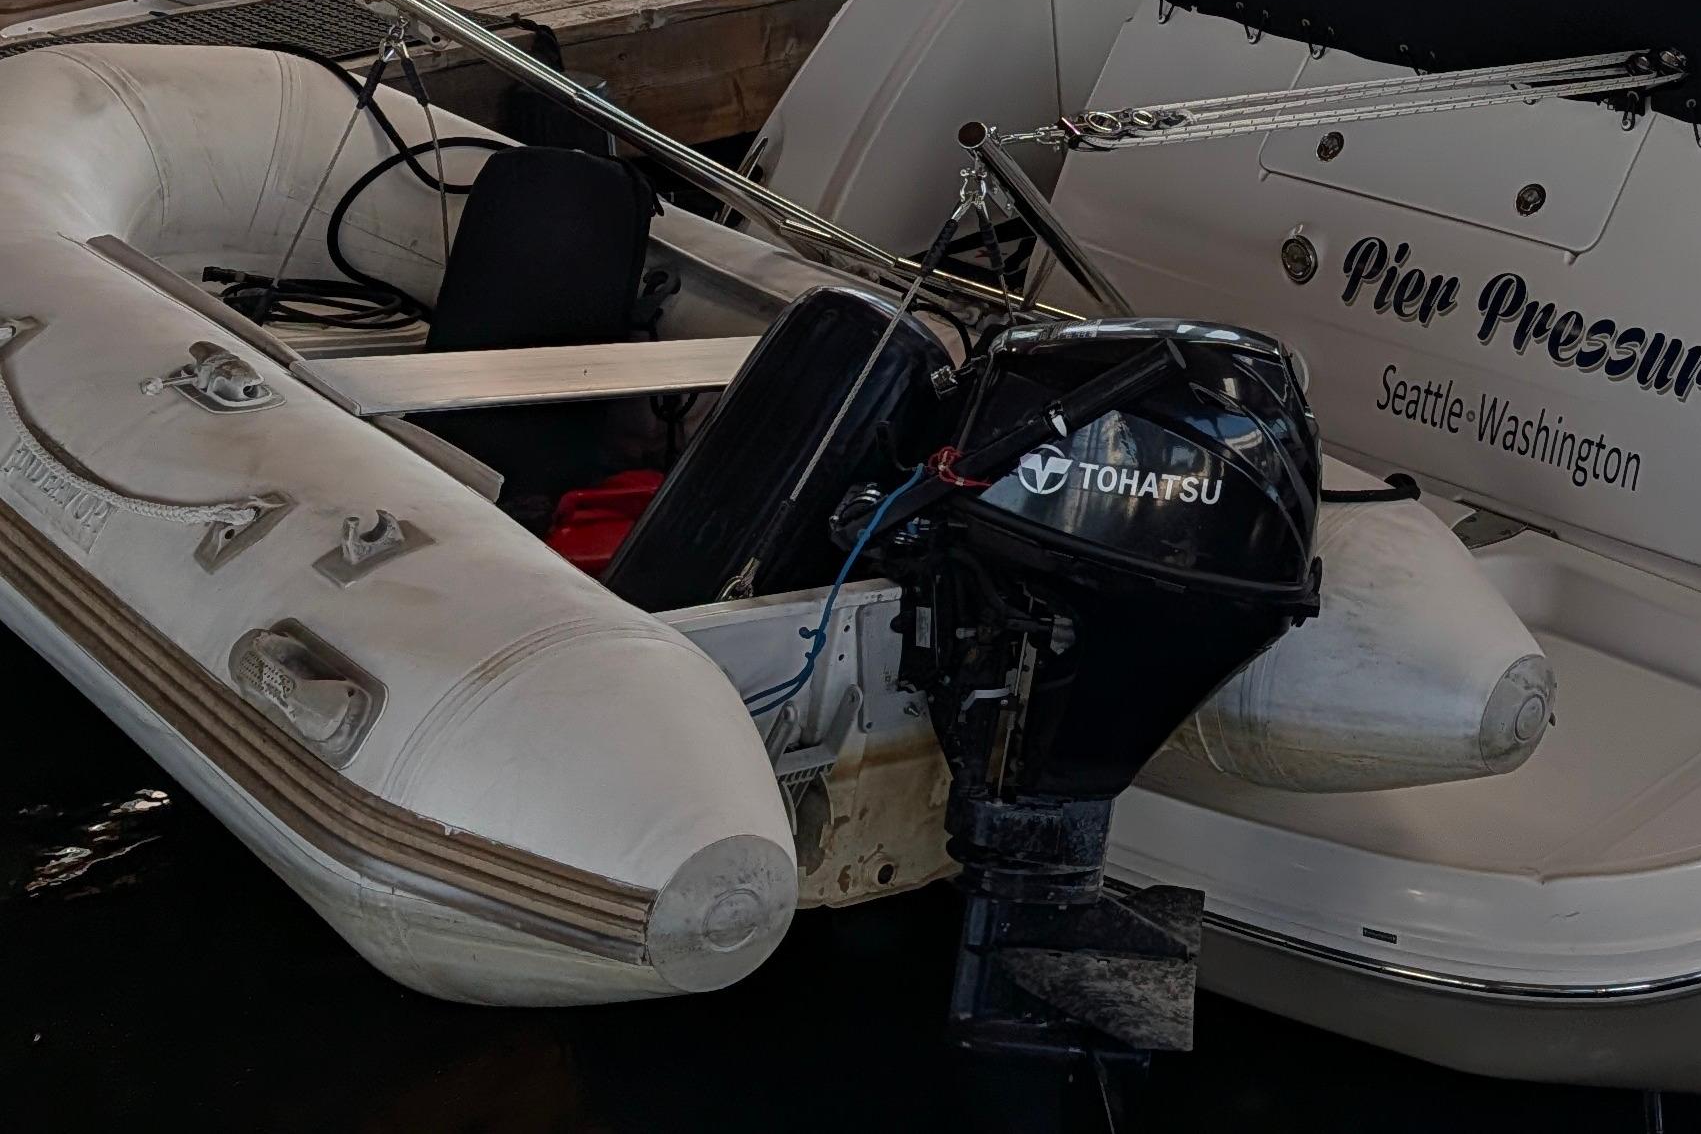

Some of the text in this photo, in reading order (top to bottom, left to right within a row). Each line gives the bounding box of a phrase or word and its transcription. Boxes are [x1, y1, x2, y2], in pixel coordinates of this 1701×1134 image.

[1341, 235, 1461, 328] Pier
[1376, 363, 1642, 492] Seattle Washington
[1078, 461, 1224, 506] TOHATSU
